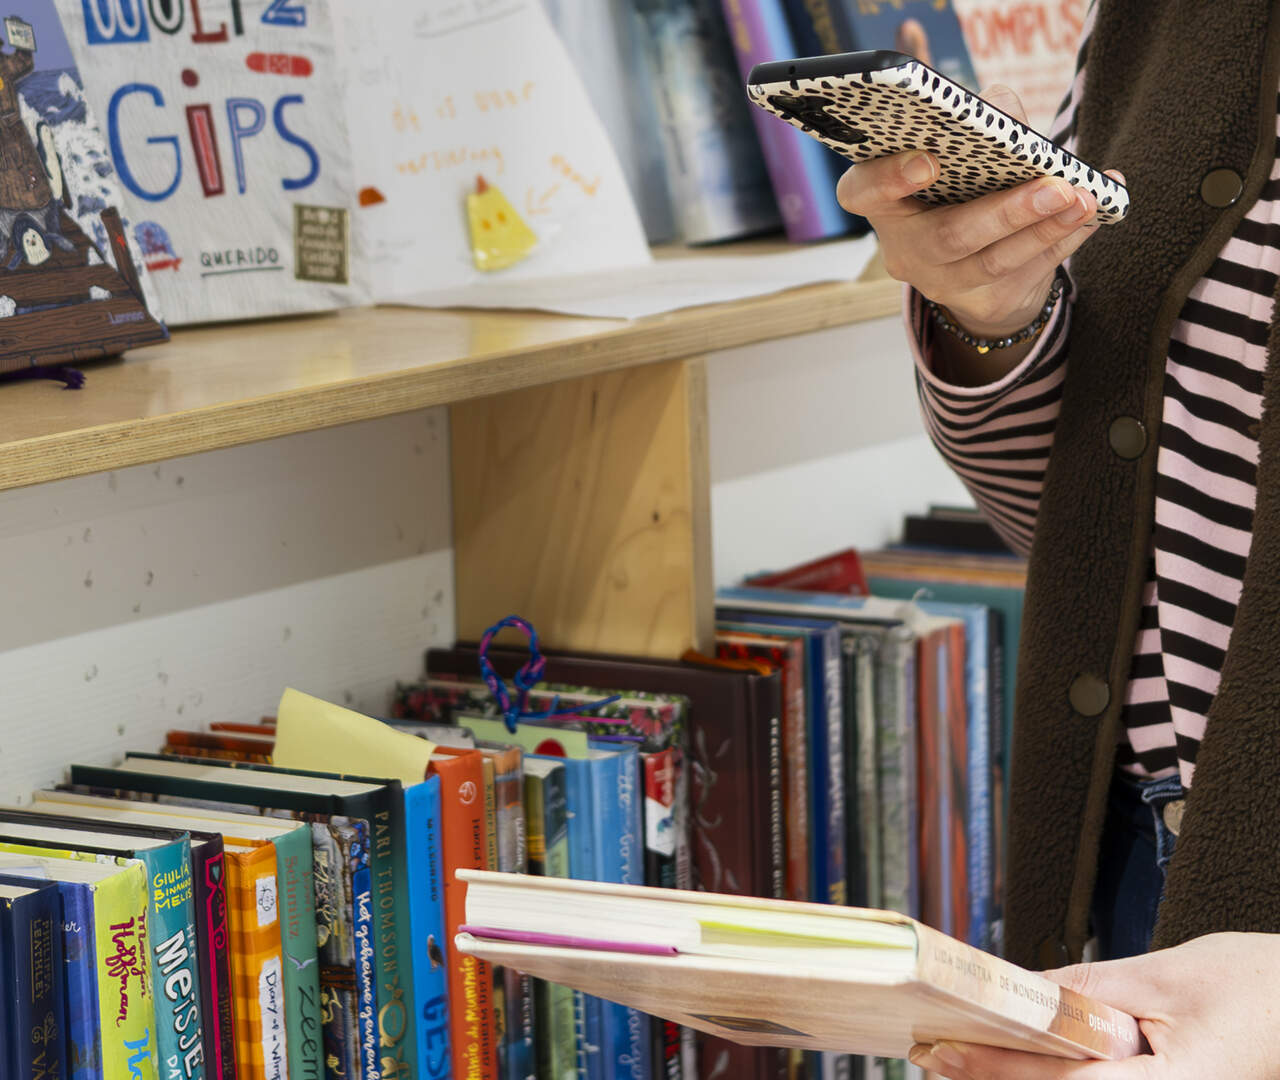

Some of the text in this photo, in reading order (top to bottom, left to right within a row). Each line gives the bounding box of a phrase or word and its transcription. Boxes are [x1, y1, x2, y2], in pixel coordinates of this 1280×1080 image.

[199, 247, 280, 268] QUERIDO
[152, 863, 191, 888] GIULIA
[154, 891, 193, 914] MELIS
[284, 855, 301, 940] Schmitz
[374, 810, 399, 973] PARI THOMSON
[265, 971, 278, 1016] Diary
[354, 924, 374, 1010] geheime
[933, 947, 954, 966] LIDA
[954, 953, 993, 983] DIJKSTRA
[999, 975, 1010, 991] DE
[1011, 982, 1086, 1023] WONDERVERTELLER
